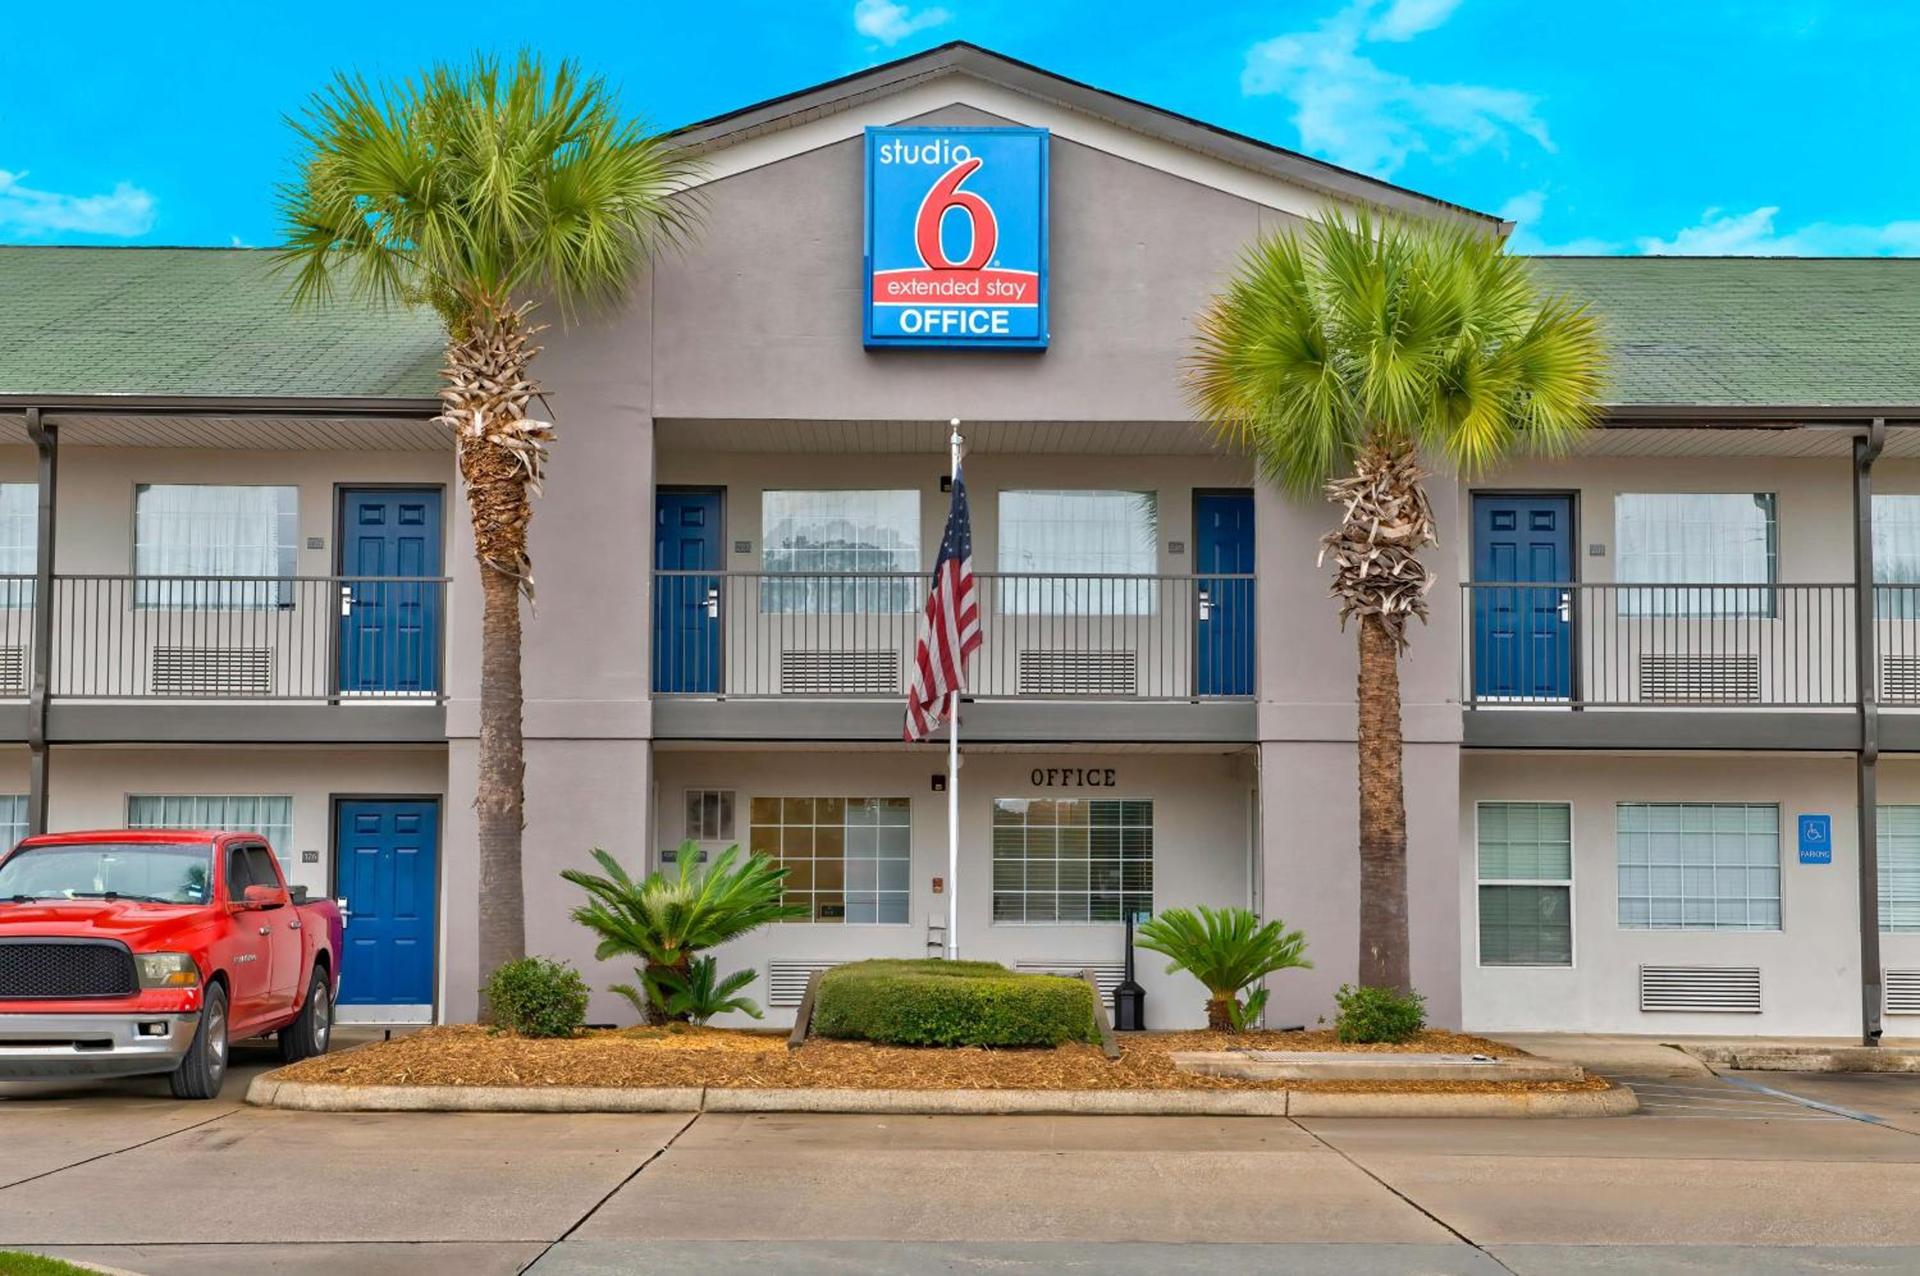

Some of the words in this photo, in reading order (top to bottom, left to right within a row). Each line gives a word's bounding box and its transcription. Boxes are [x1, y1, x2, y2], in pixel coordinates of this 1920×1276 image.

[880, 139, 971, 165] studio
[914, 156, 999, 271] 6
[887, 279, 979, 296] extended
[986, 280, 1026, 300] stay
[899, 309, 1010, 334] OFFICE
[1031, 768, 1116, 787] OFFICE
[1801, 850, 1830, 858] PARKING
